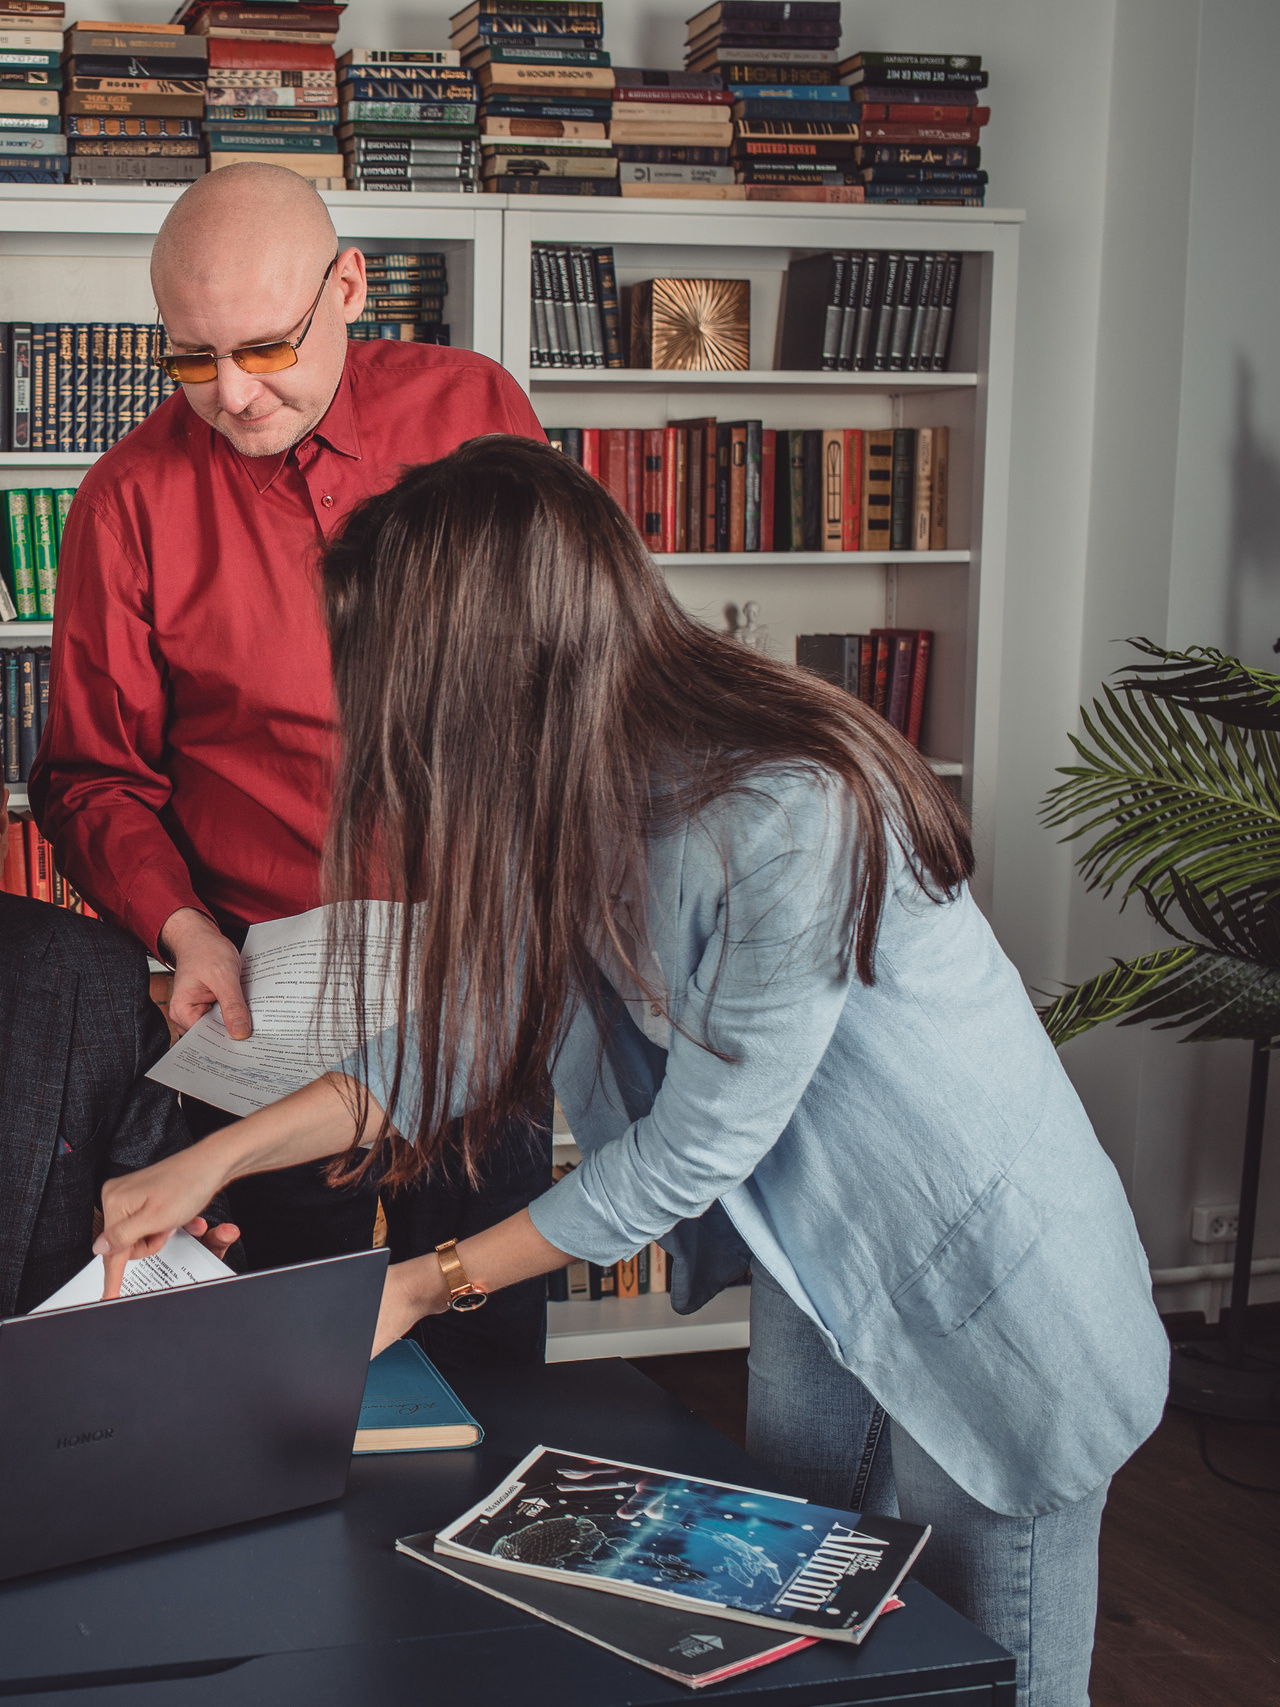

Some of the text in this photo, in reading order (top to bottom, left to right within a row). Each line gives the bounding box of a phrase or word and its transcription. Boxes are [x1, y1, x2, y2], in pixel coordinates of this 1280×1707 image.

[901, 70, 912, 80] ER
[913, 70, 931, 81] BARN
[56, 1428, 115, 1450] HONOR
[777, 1521, 891, 1612] Alumni
